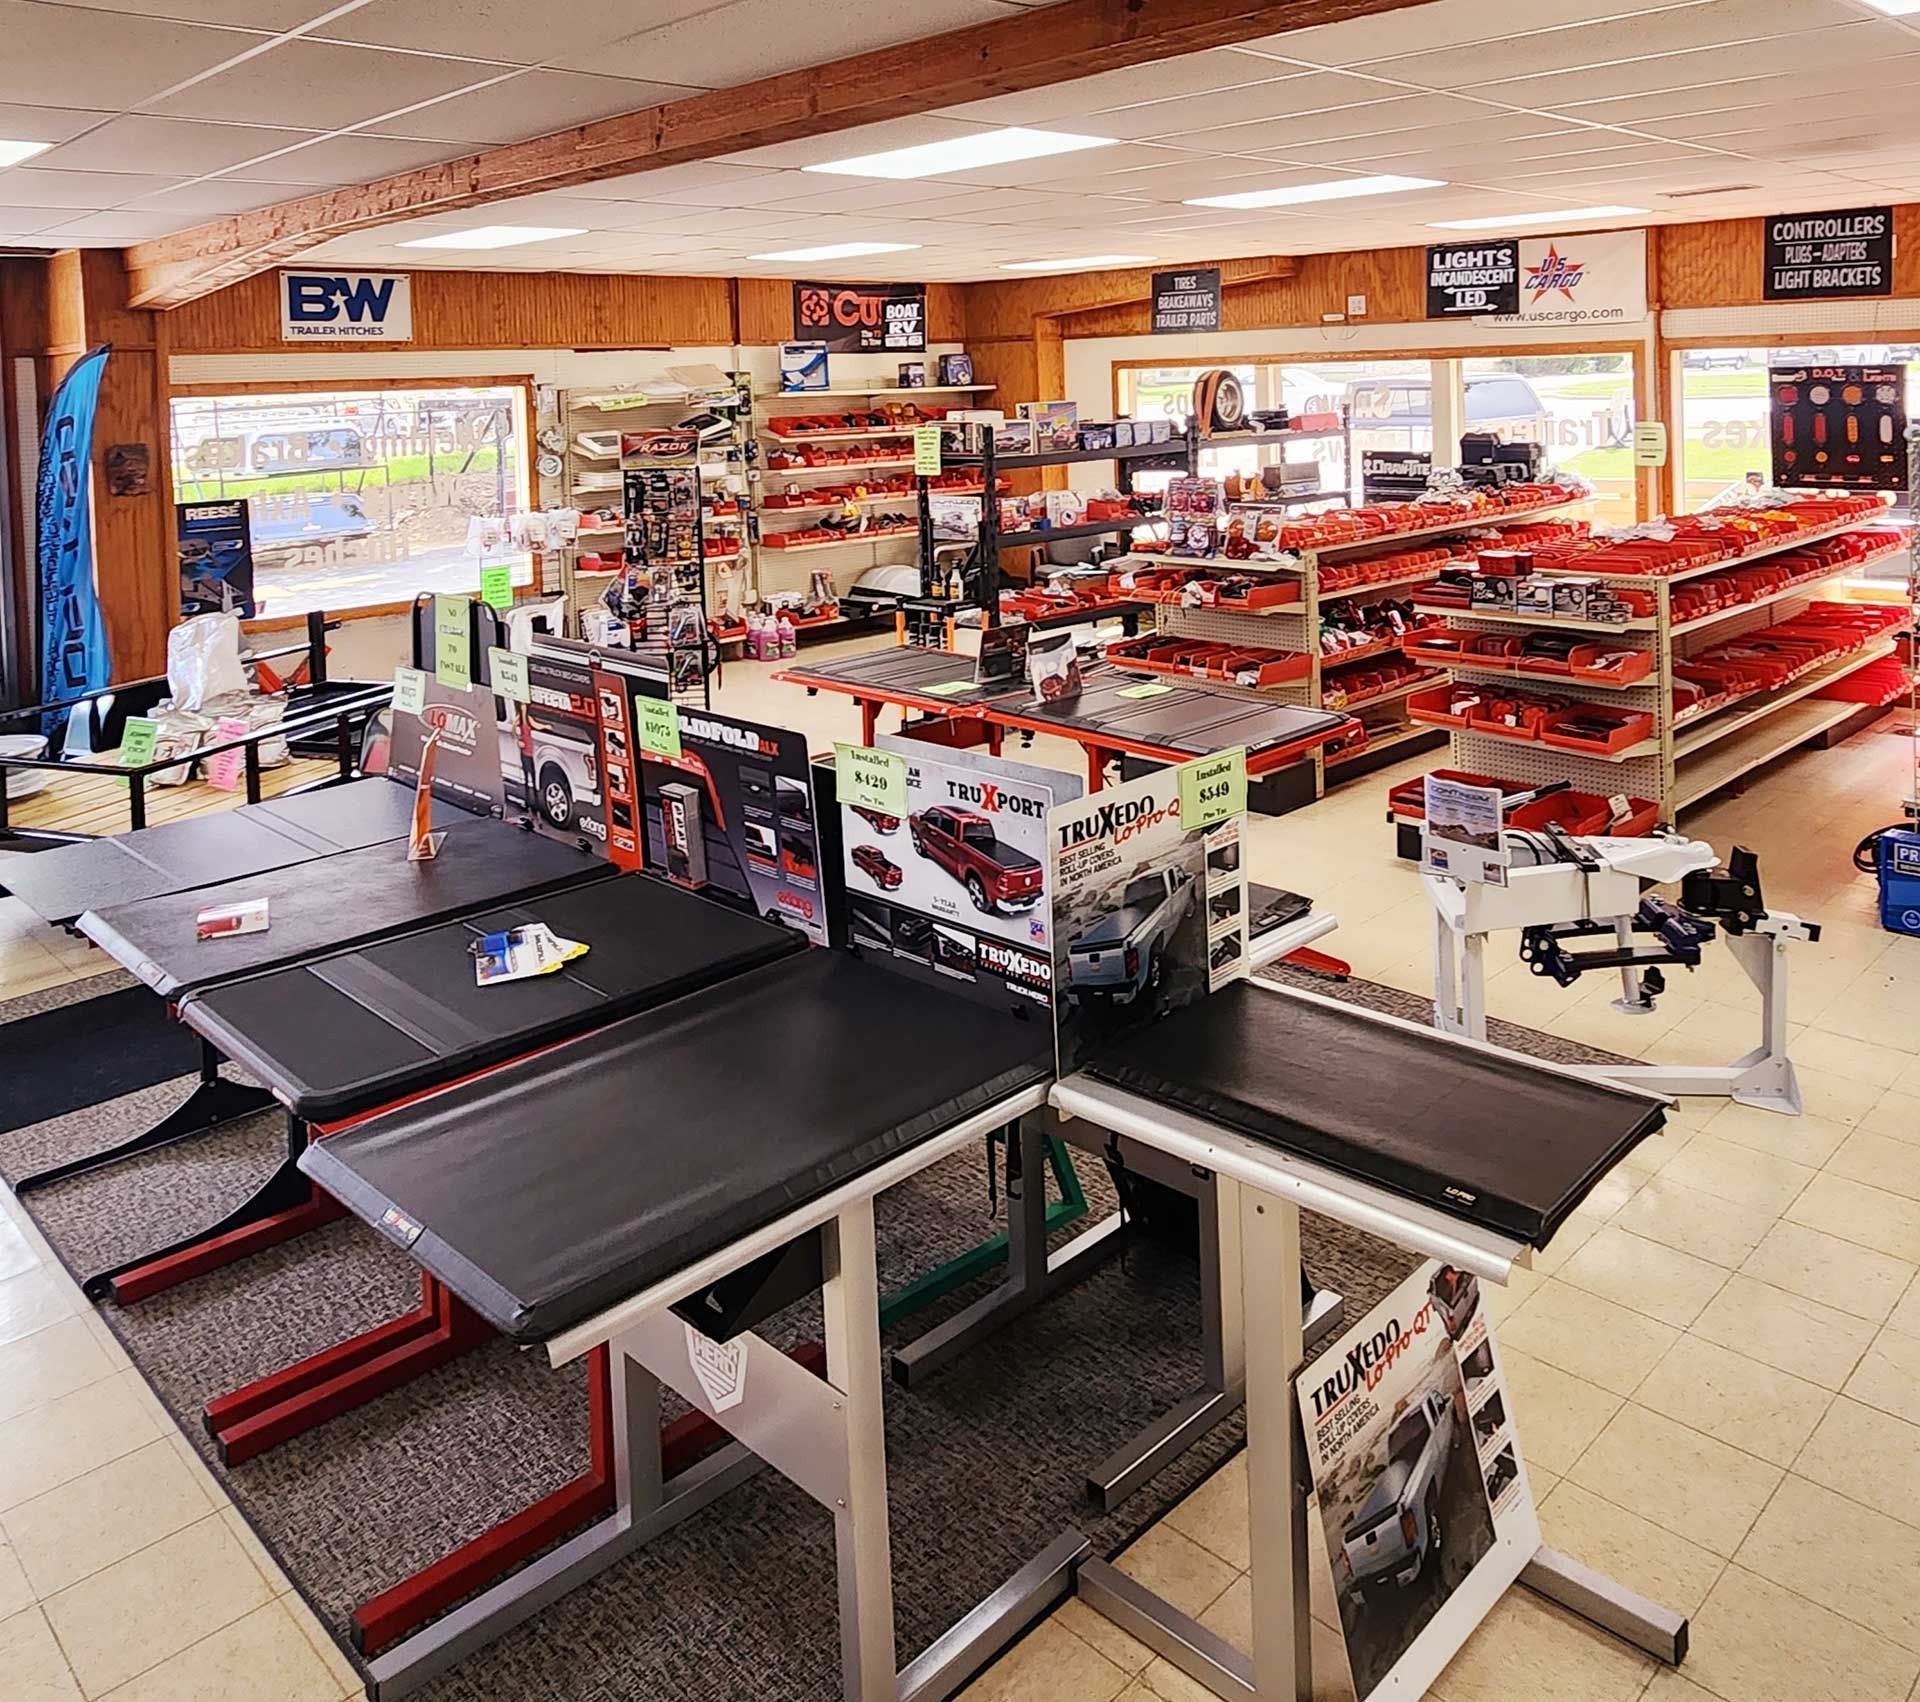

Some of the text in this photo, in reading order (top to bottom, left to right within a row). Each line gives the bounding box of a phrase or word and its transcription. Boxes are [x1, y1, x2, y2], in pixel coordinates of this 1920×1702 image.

[1773, 215, 1885, 241] CONTROLLERS
[1433, 249, 1513, 269] LIGHTS
[1785, 245, 1813, 264] PLUGS
[1821, 241, 1868, 262] ADAPTERS
[1174, 276, 1197, 290] TIRES
[1430, 268, 1516, 287] INCANDESCENT
[1524, 272, 1584, 290] CARGO
[1774, 266, 1882, 290] LIGHT BRACKETS
[834, 291, 882, 326] CU
[1456, 290, 1487, 307] LED
[886, 304, 920, 318] BOAT
[1156, 311, 1217, 328] TRAILER PARTS
[290, 326, 384, 336] TRAILER HITCHES
[889, 321, 917, 334] RV
[640, 442, 690, 454] RAZOR
[185, 505, 241, 521] REESE
[679, 714, 760, 751] LIDFOLD
[851, 749, 889, 768] Installed
[855, 770, 888, 791] $429
[1196, 760, 1231, 781] Installed
[946, 780, 1045, 819] TRUXPORT
[1199, 781, 1230, 804] $549
[1167, 797, 1181, 817] Q
[1058, 795, 1155, 849] TRUXEDO
[1059, 842, 1106, 868] BEST SELLING
[1089, 848, 1115, 866] COVERS
[1059, 855, 1122, 888] IN NORTH AMERICA
[978, 943, 1052, 981] TRUXEDO
[1311, 1318, 1401, 1418] TRUXEDO
[1316, 1394, 1361, 1441] BEST SELLING
[1347, 1398, 1372, 1425] COVERS
[1321, 1403, 1381, 1466] IN NORTH AMERICA
